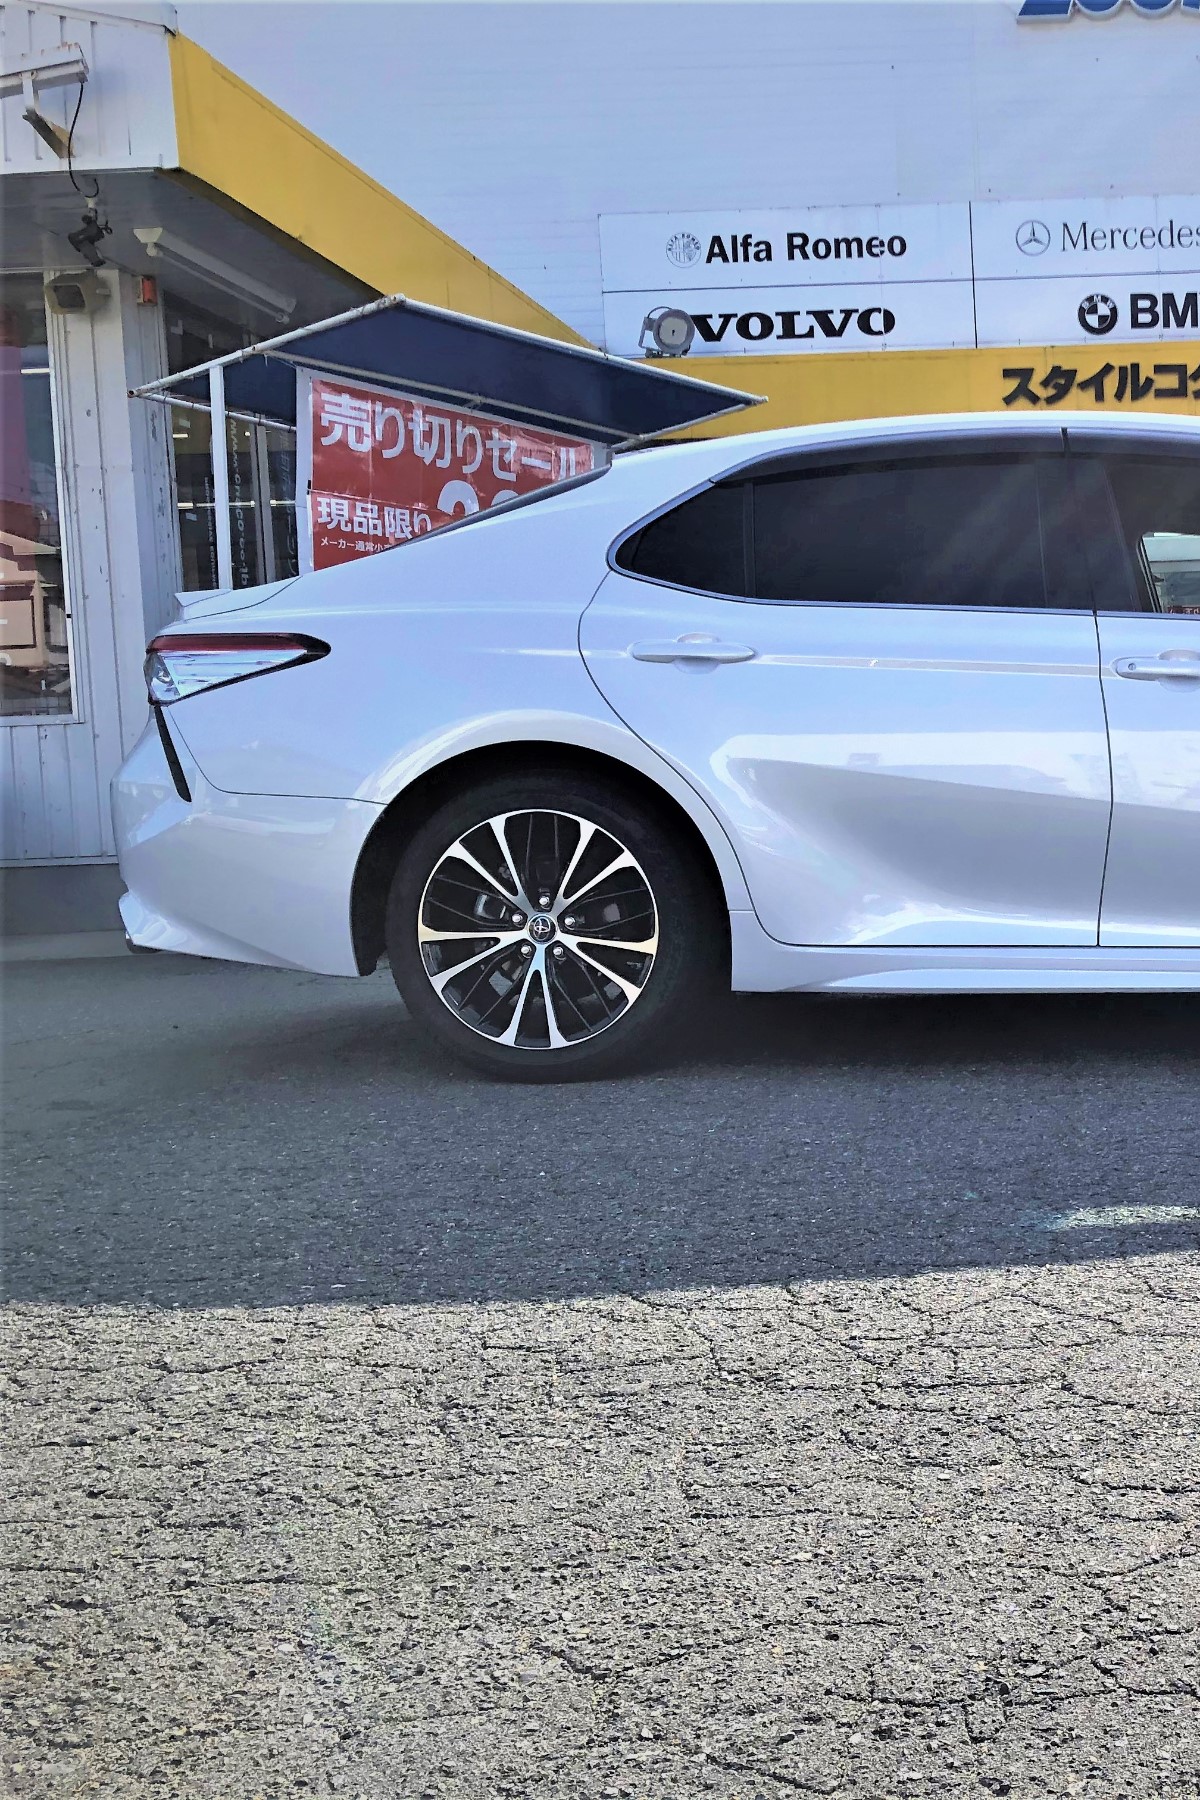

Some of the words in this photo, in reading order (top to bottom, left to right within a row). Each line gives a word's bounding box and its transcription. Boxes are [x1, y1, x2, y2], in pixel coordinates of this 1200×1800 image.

[705, 233, 774, 264] Alfa
[786, 232, 907, 261] Romeo
[690, 307, 896, 343] VOLVO
[316, 497, 432, 540] 現品限り
